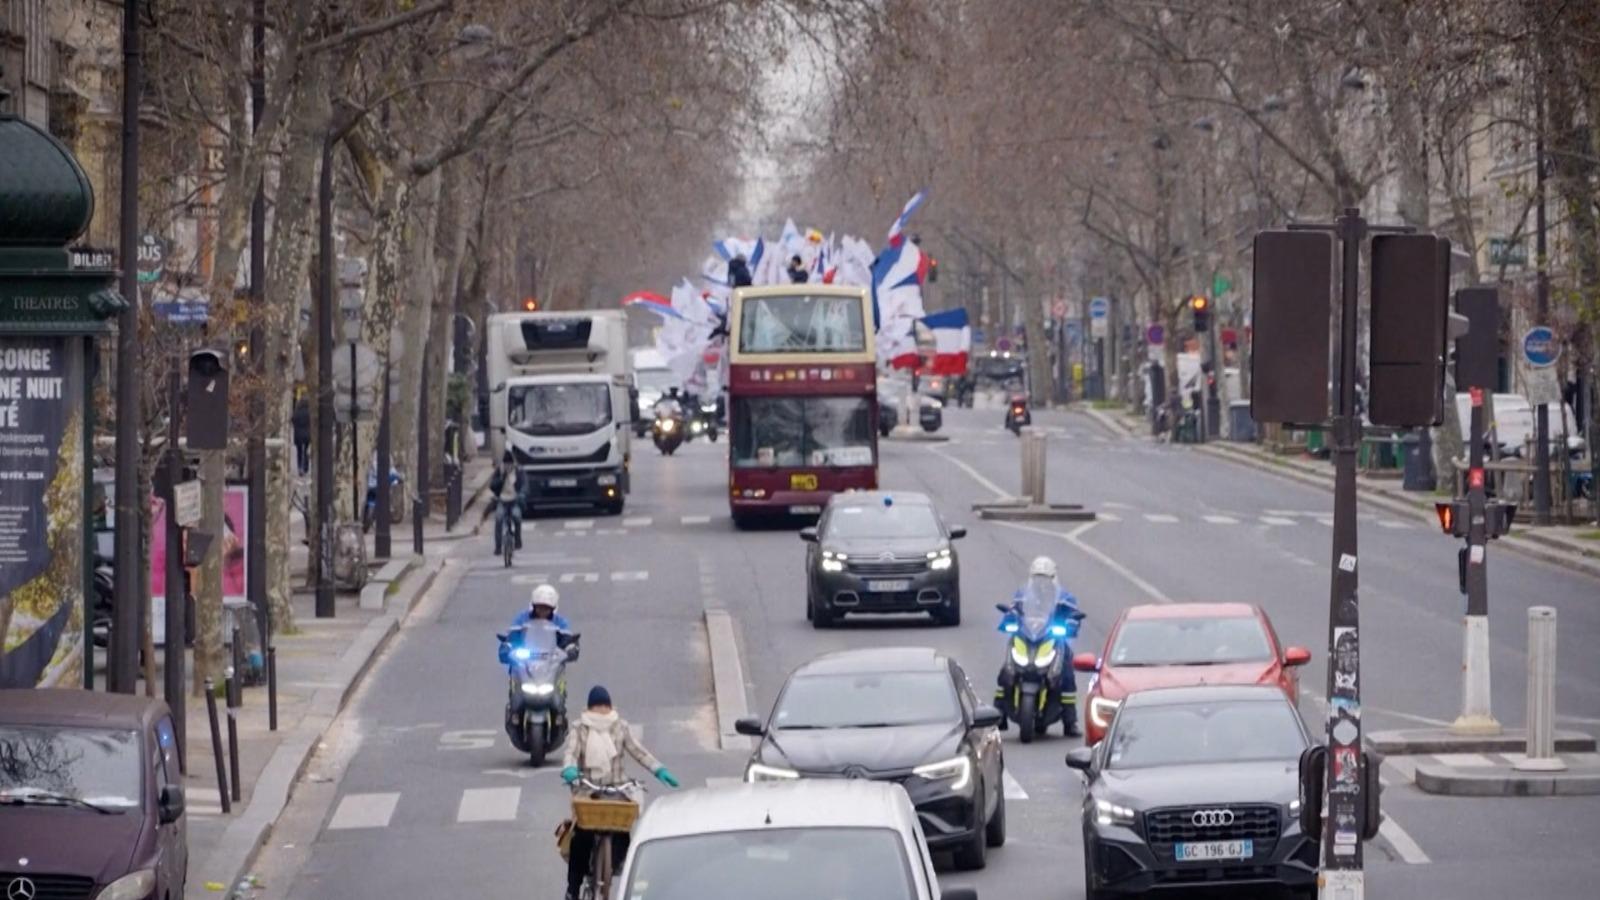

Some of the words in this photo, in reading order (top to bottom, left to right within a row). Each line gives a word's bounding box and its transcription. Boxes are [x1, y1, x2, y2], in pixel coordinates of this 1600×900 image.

[26, 377, 63, 399] NUIT
[1184, 844, 1198, 857] GC
[1204, 843, 1224, 857] 196
[1228, 842, 1243, 855] GJ
